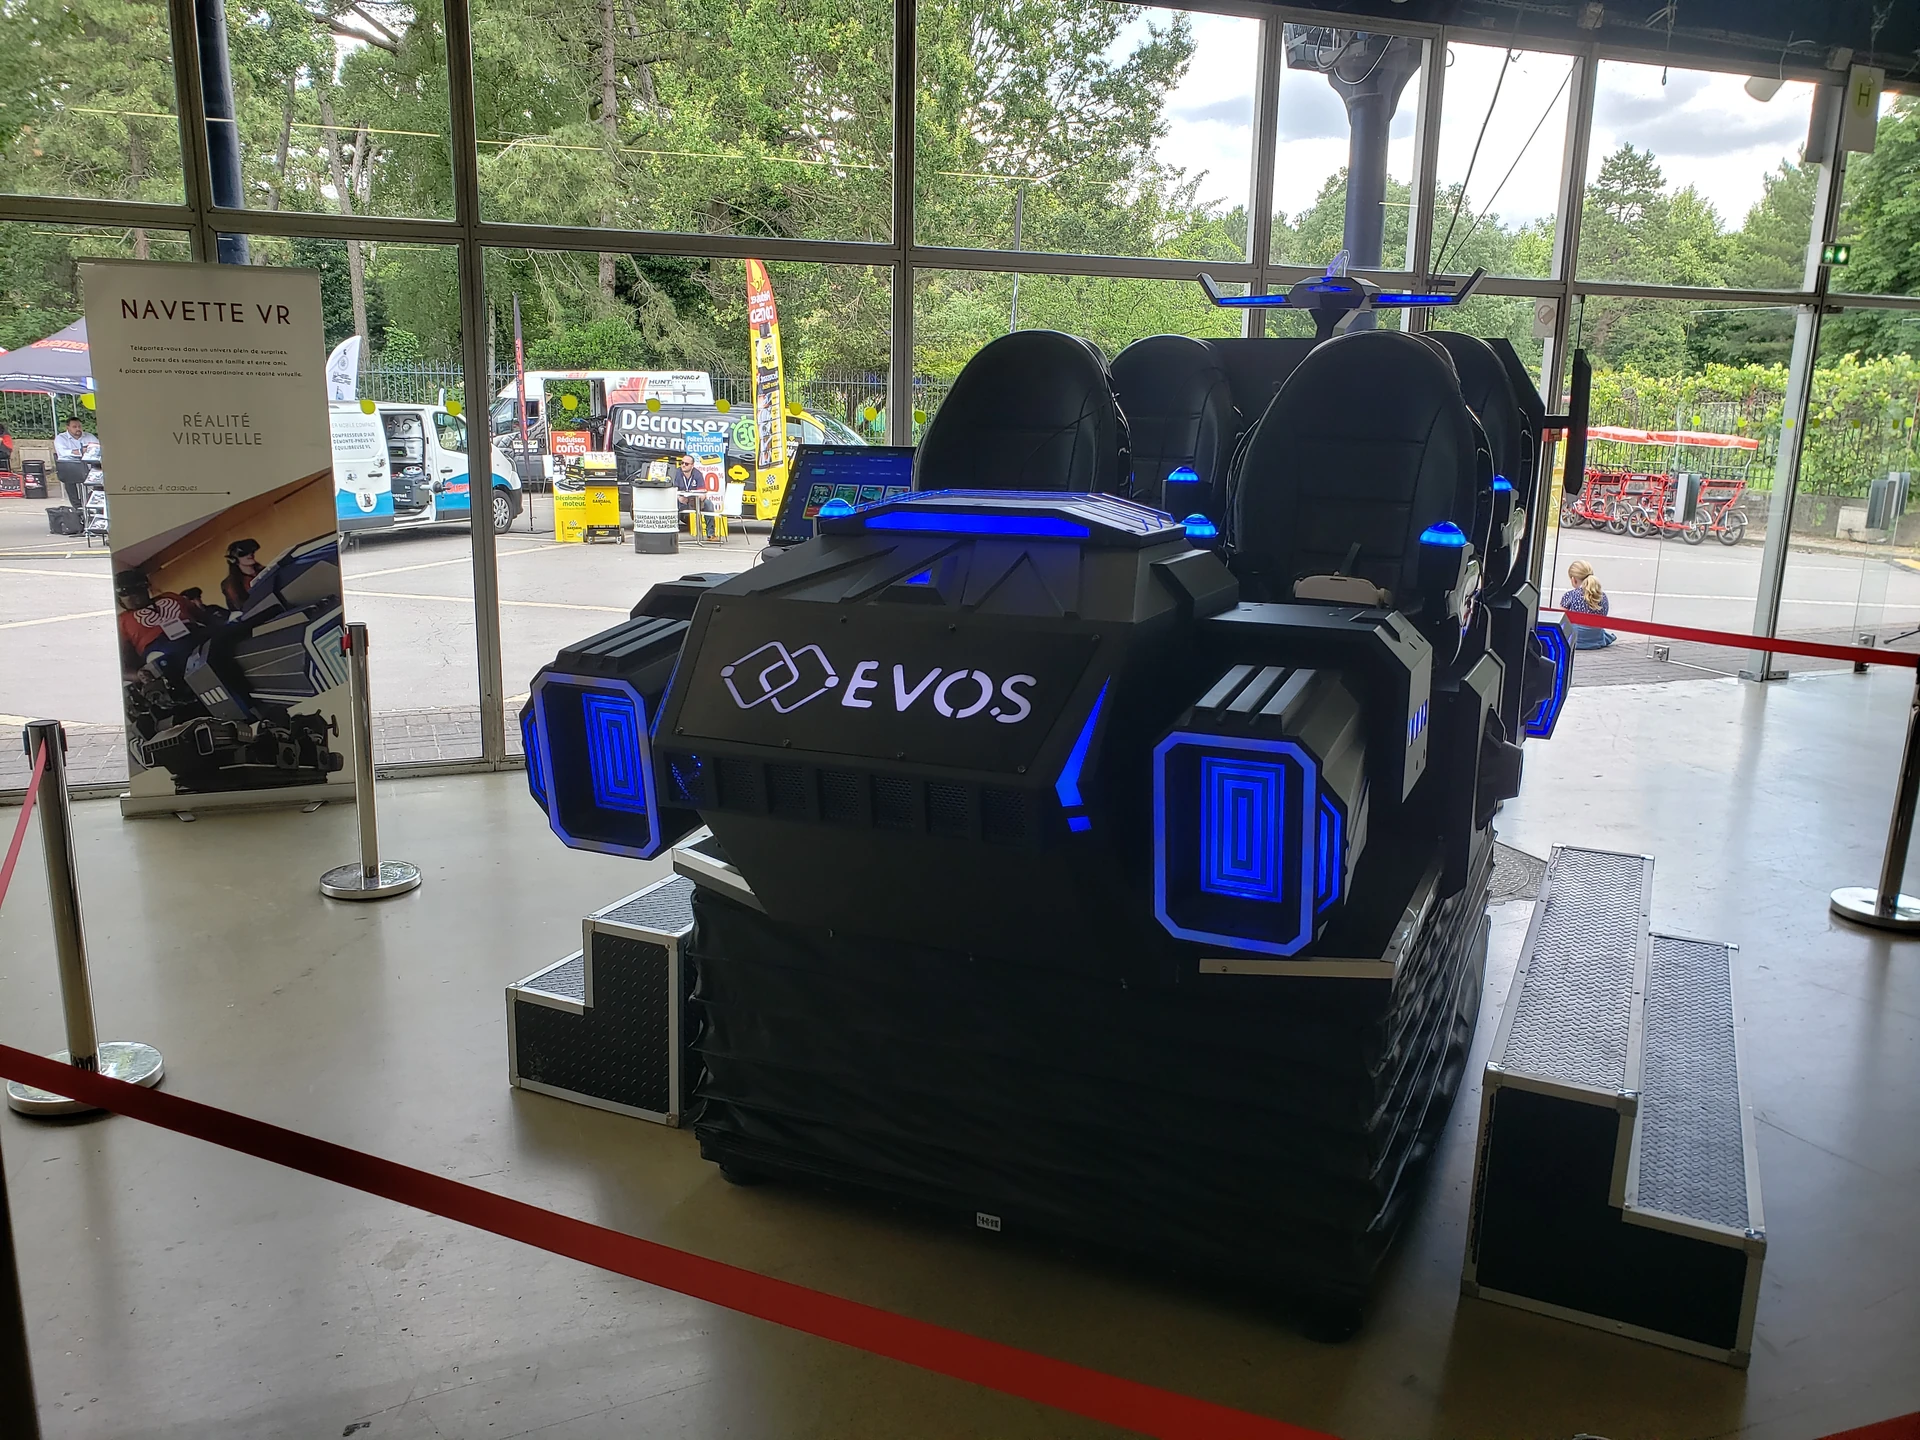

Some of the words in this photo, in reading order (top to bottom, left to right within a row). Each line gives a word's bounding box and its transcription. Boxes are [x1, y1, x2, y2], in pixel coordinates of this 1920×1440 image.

[1857, 82, 1872, 108] H
[120, 298, 244, 323] NAVETTE
[255, 303, 291, 325] VR
[182, 411, 250, 428] RÉALITÉ
[622, 409, 730, 438] Décrassez
[172, 431, 263, 446] VIRTUELLE
[556, 444, 587, 453] conso
[624, 433, 667, 448] votre
[841, 659, 1037, 724] EVOS
